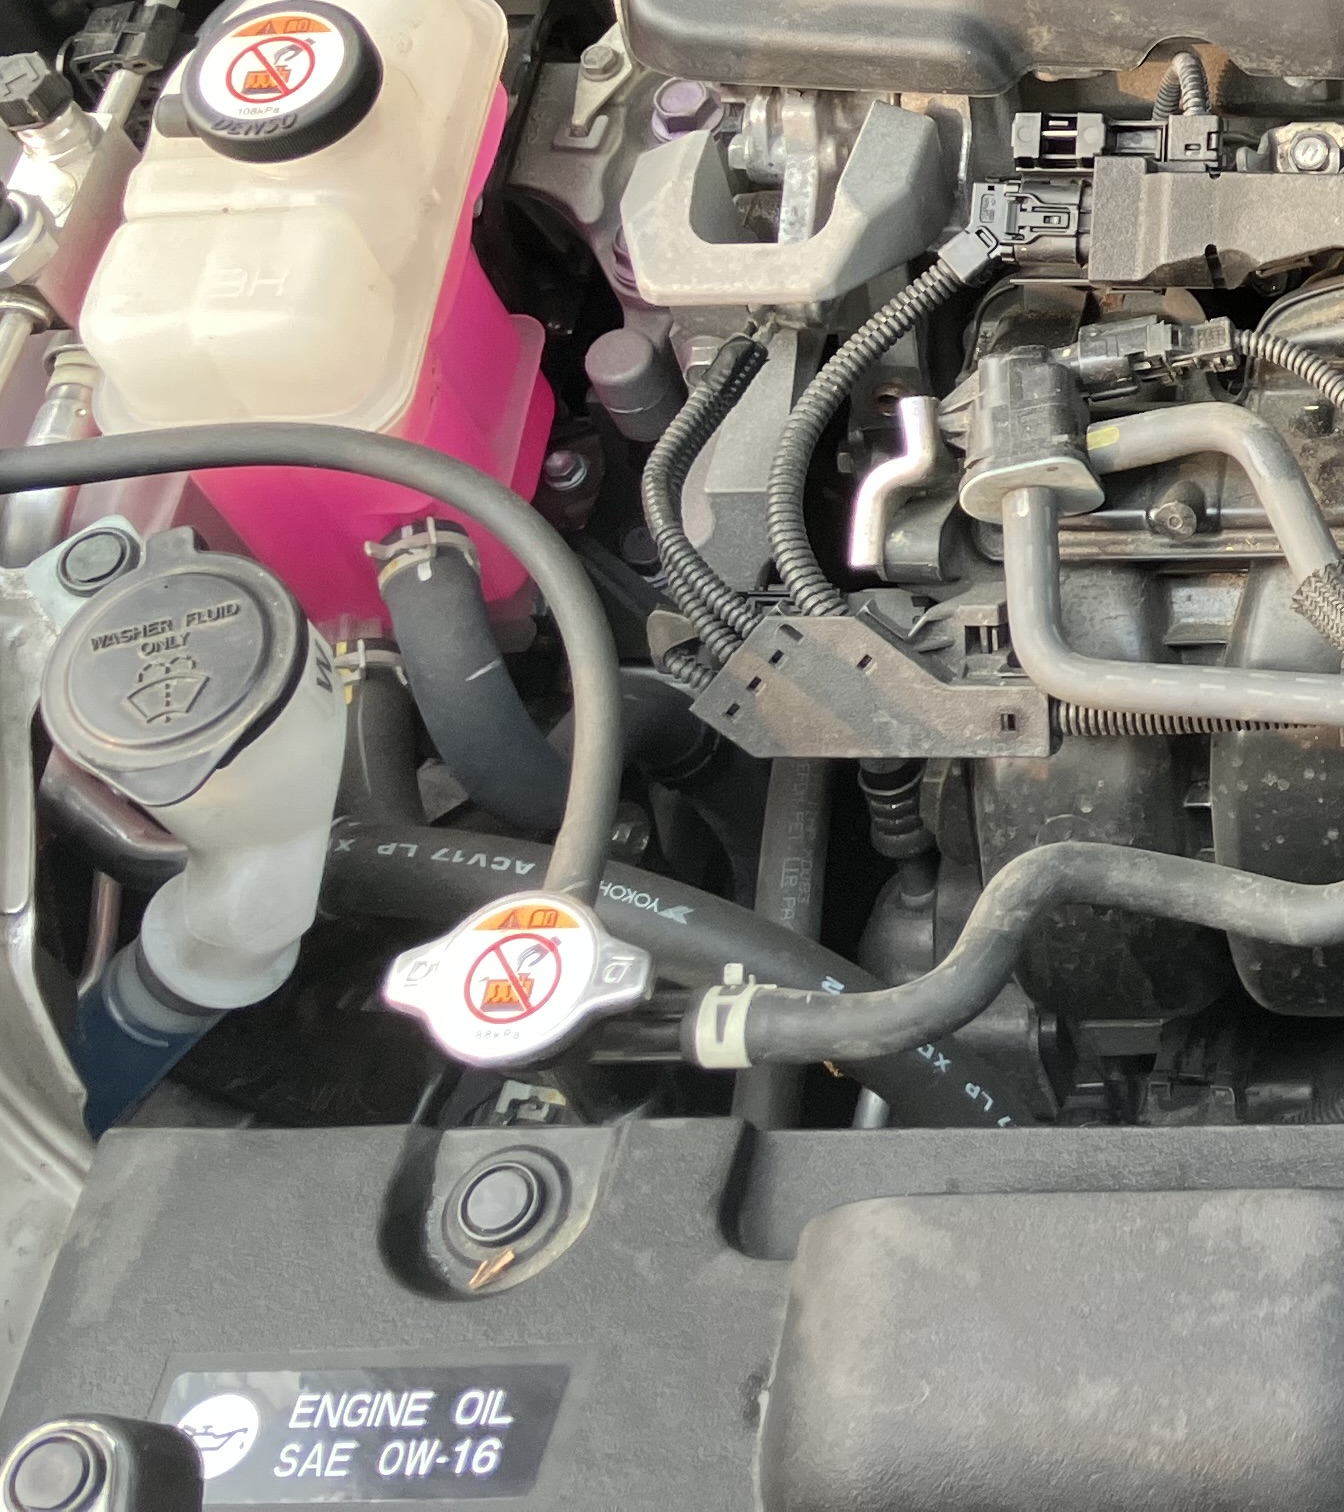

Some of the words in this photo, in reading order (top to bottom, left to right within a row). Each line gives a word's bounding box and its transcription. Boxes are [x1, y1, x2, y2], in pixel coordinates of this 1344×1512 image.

[211, 112, 298, 136] DENSO
[90, 619, 174, 652] WASHER
[186, 603, 241, 627] FLUID
[139, 632, 191, 657] ONLY
[377, 842, 418, 858] LP
[431, 848, 535, 875] ACV17
[965, 1082, 993, 1112] LP
[288, 1390, 437, 1429] ENGINE
[453, 1389, 514, 1427] OIL
[273, 1440, 359, 1478] SAE
[378, 1437, 503, 1478] 0W-16
